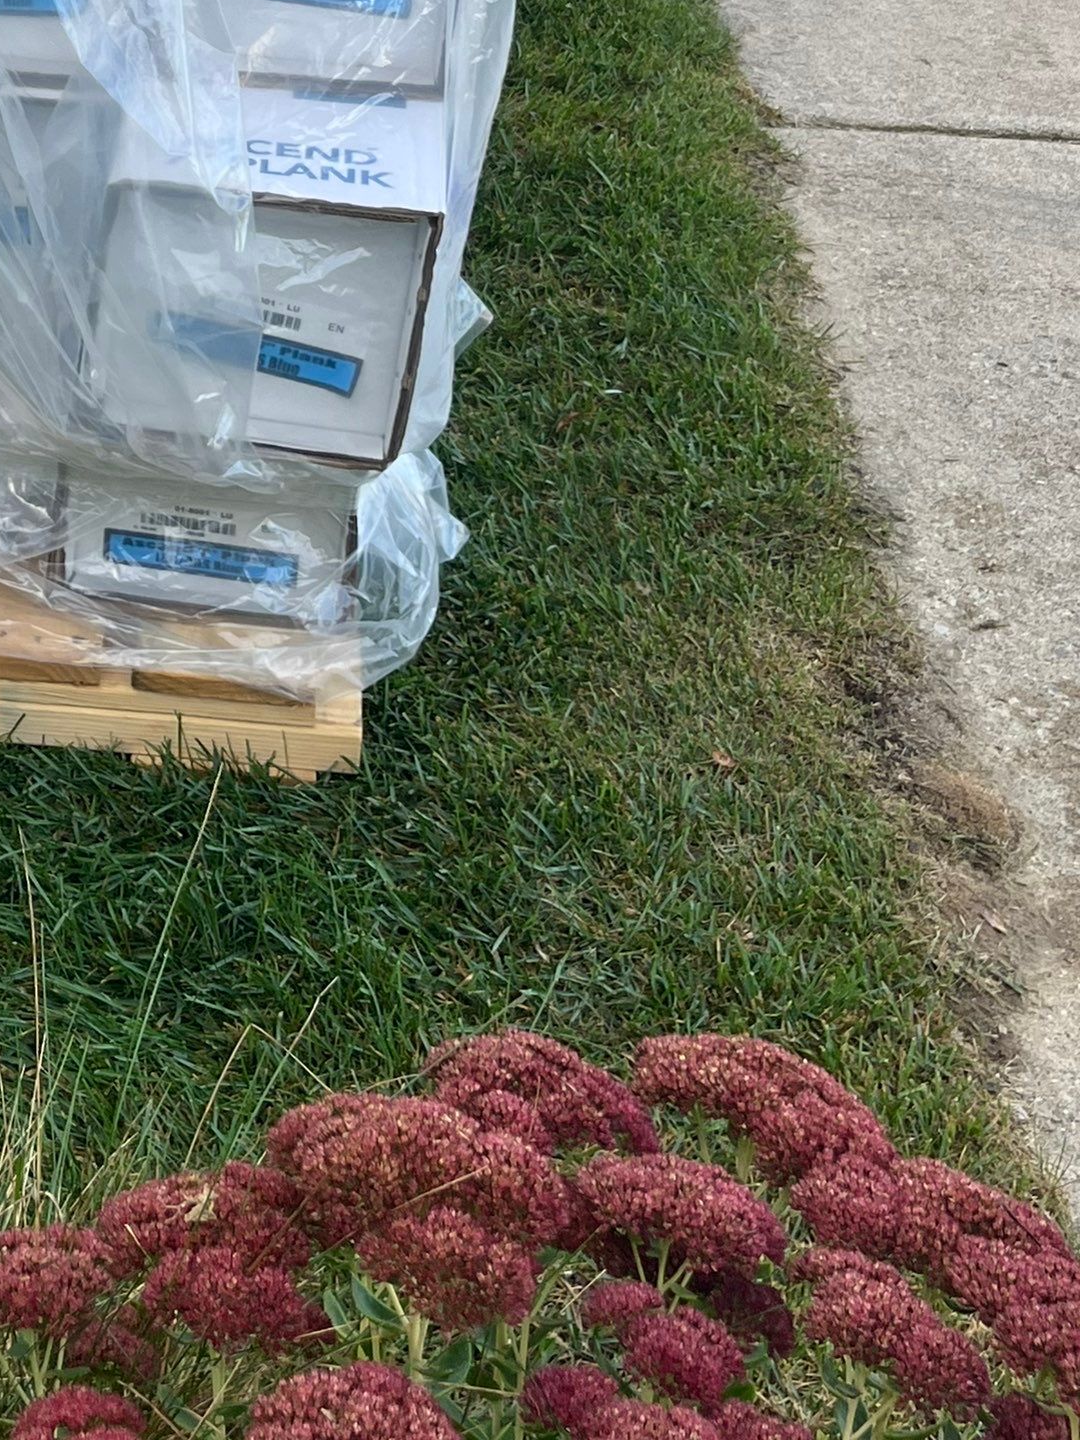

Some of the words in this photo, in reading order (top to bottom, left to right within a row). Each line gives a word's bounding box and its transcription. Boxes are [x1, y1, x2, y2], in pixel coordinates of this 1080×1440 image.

[246, 139, 378, 166] CEND
[287, 303, 300, 313] LU
[328, 323, 344, 334] EN
[280, 346, 336, 369] Plank
